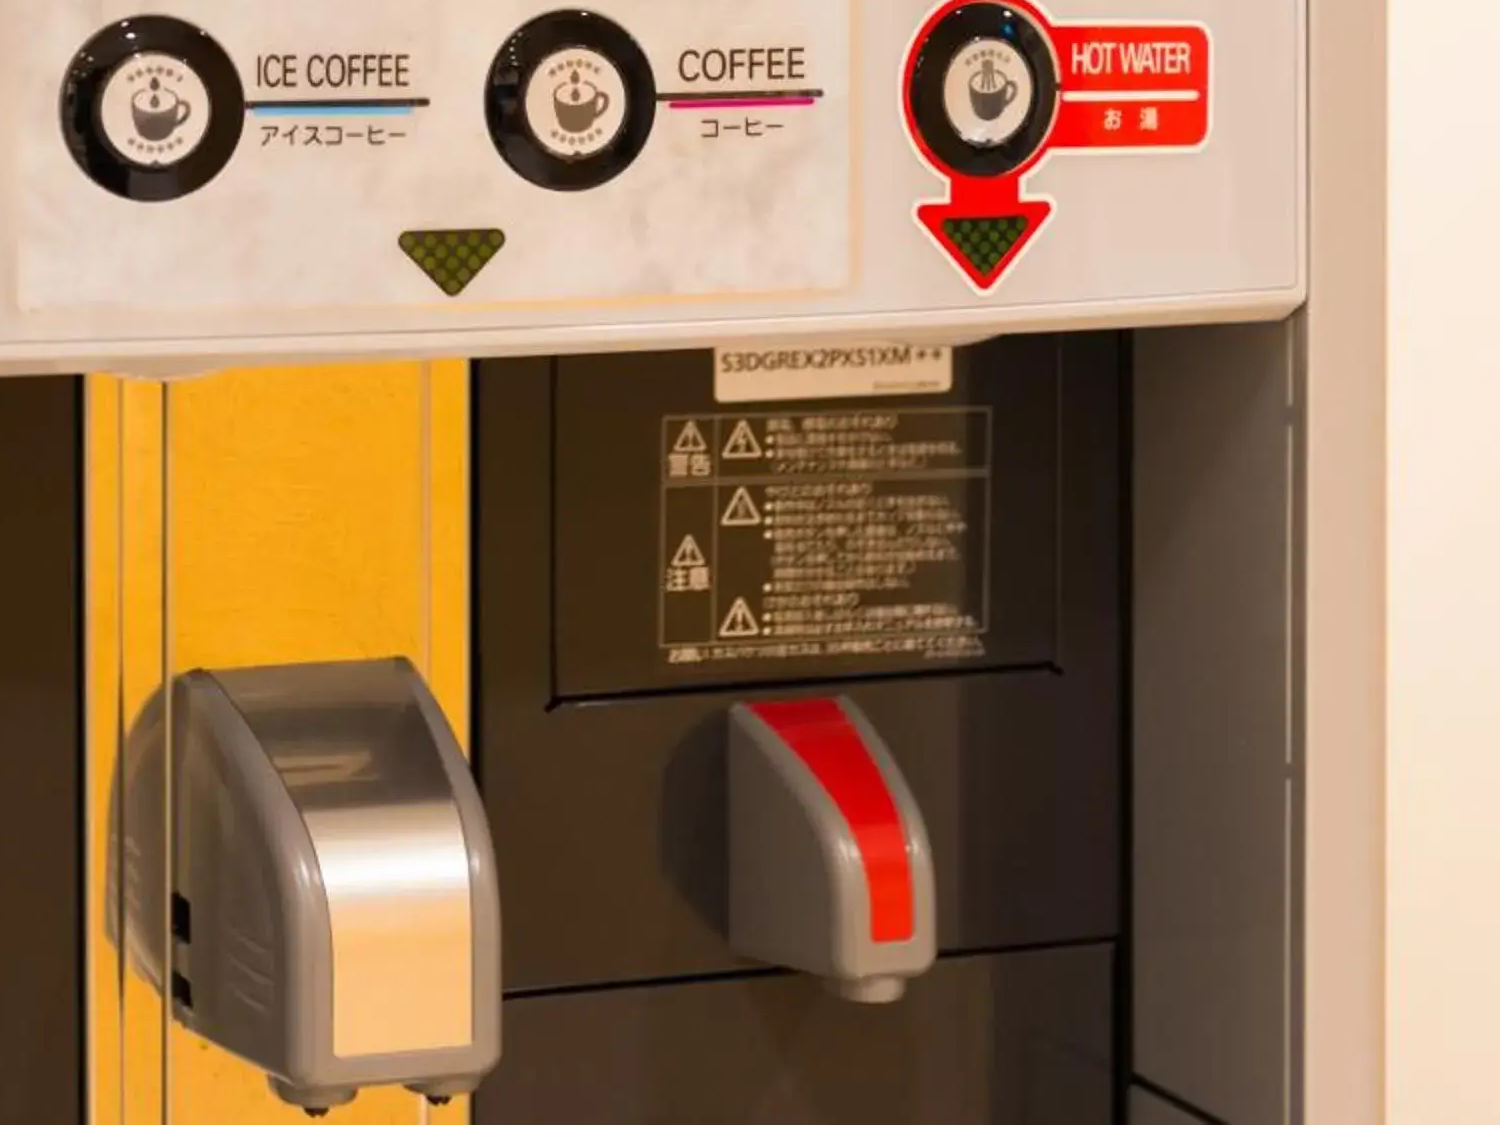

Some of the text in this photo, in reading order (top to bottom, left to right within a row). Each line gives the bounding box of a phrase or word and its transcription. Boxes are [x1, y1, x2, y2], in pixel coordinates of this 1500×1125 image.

[256, 54, 411, 89] ICE COFFEE
[677, 47, 806, 83] COFFEE
[1071, 42, 1191, 75] HOT WATER
[259, 126, 407, 147] アイスコーヒー
[700, 116, 785, 138] コーヒー
